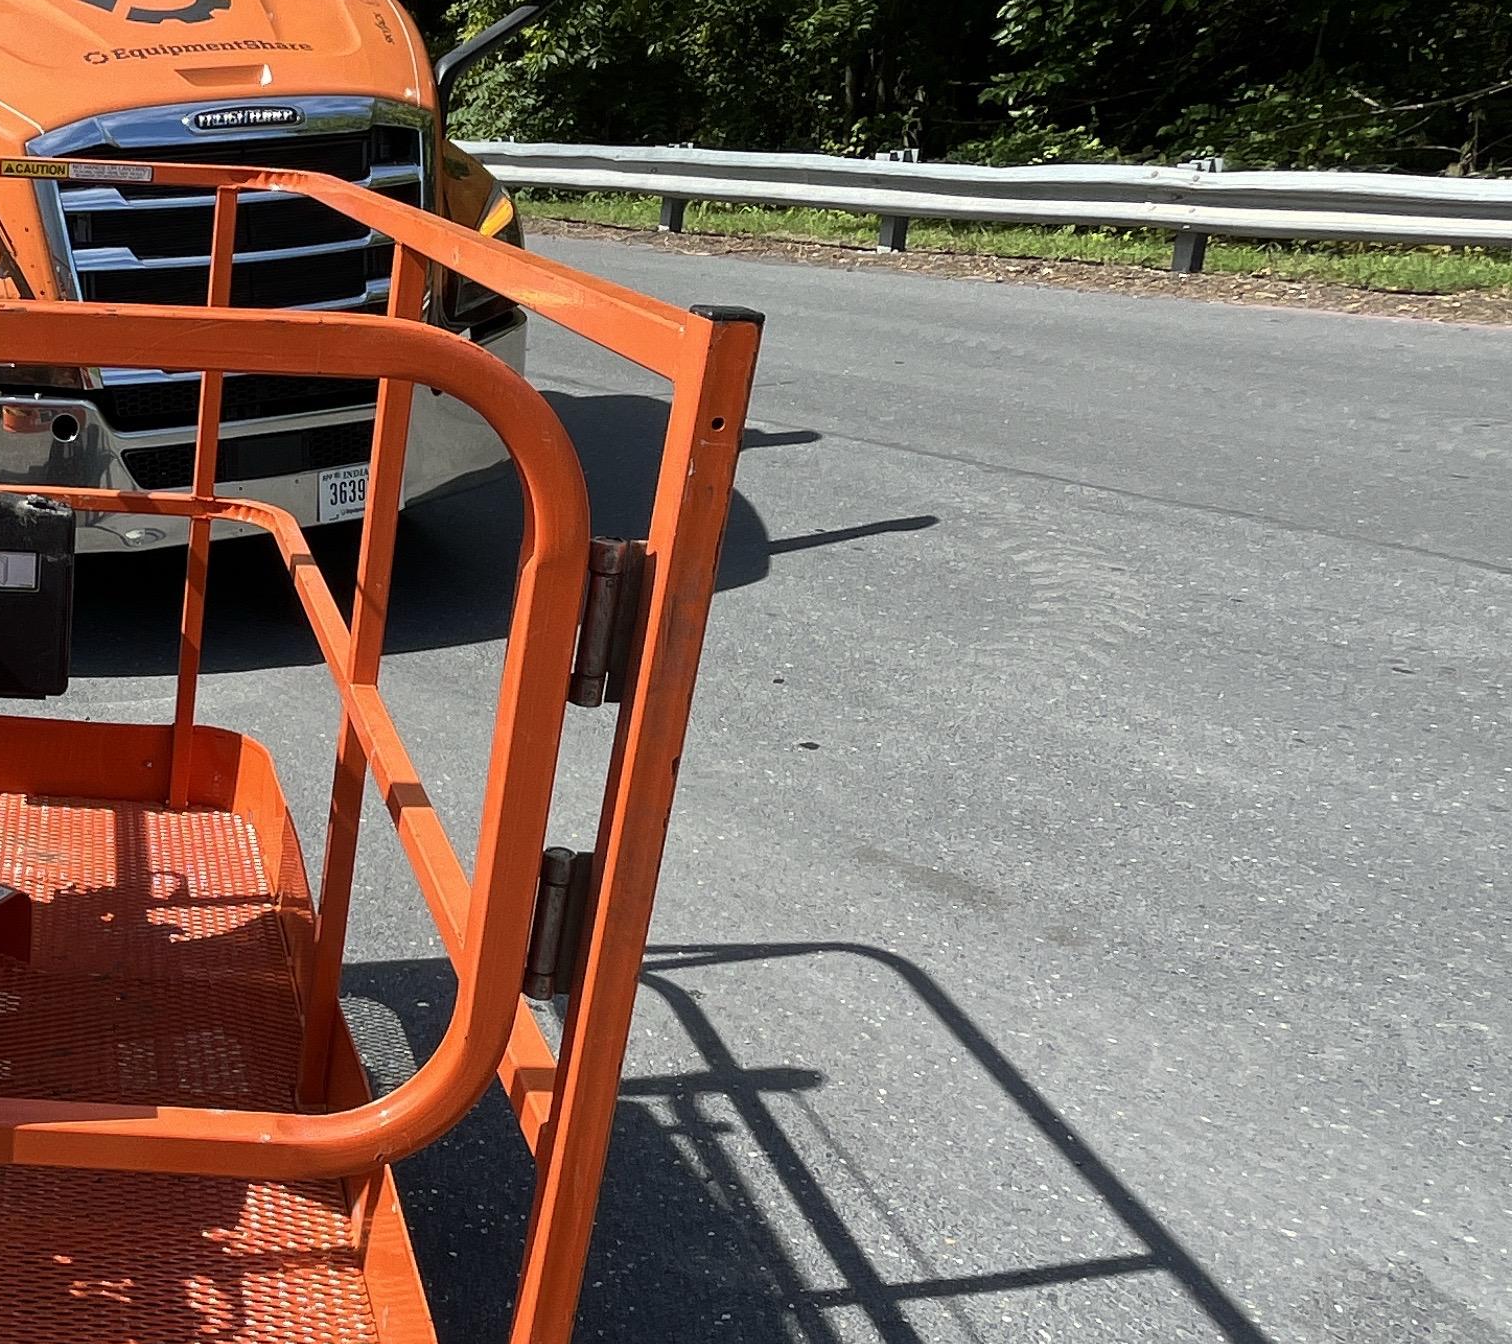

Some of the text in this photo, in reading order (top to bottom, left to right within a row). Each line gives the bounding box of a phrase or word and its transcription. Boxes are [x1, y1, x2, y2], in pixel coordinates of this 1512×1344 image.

[111, 40, 313, 60] EquipmentShare
[15, 163, 66, 175] CAUTION
[329, 478, 366, 506] 3639
